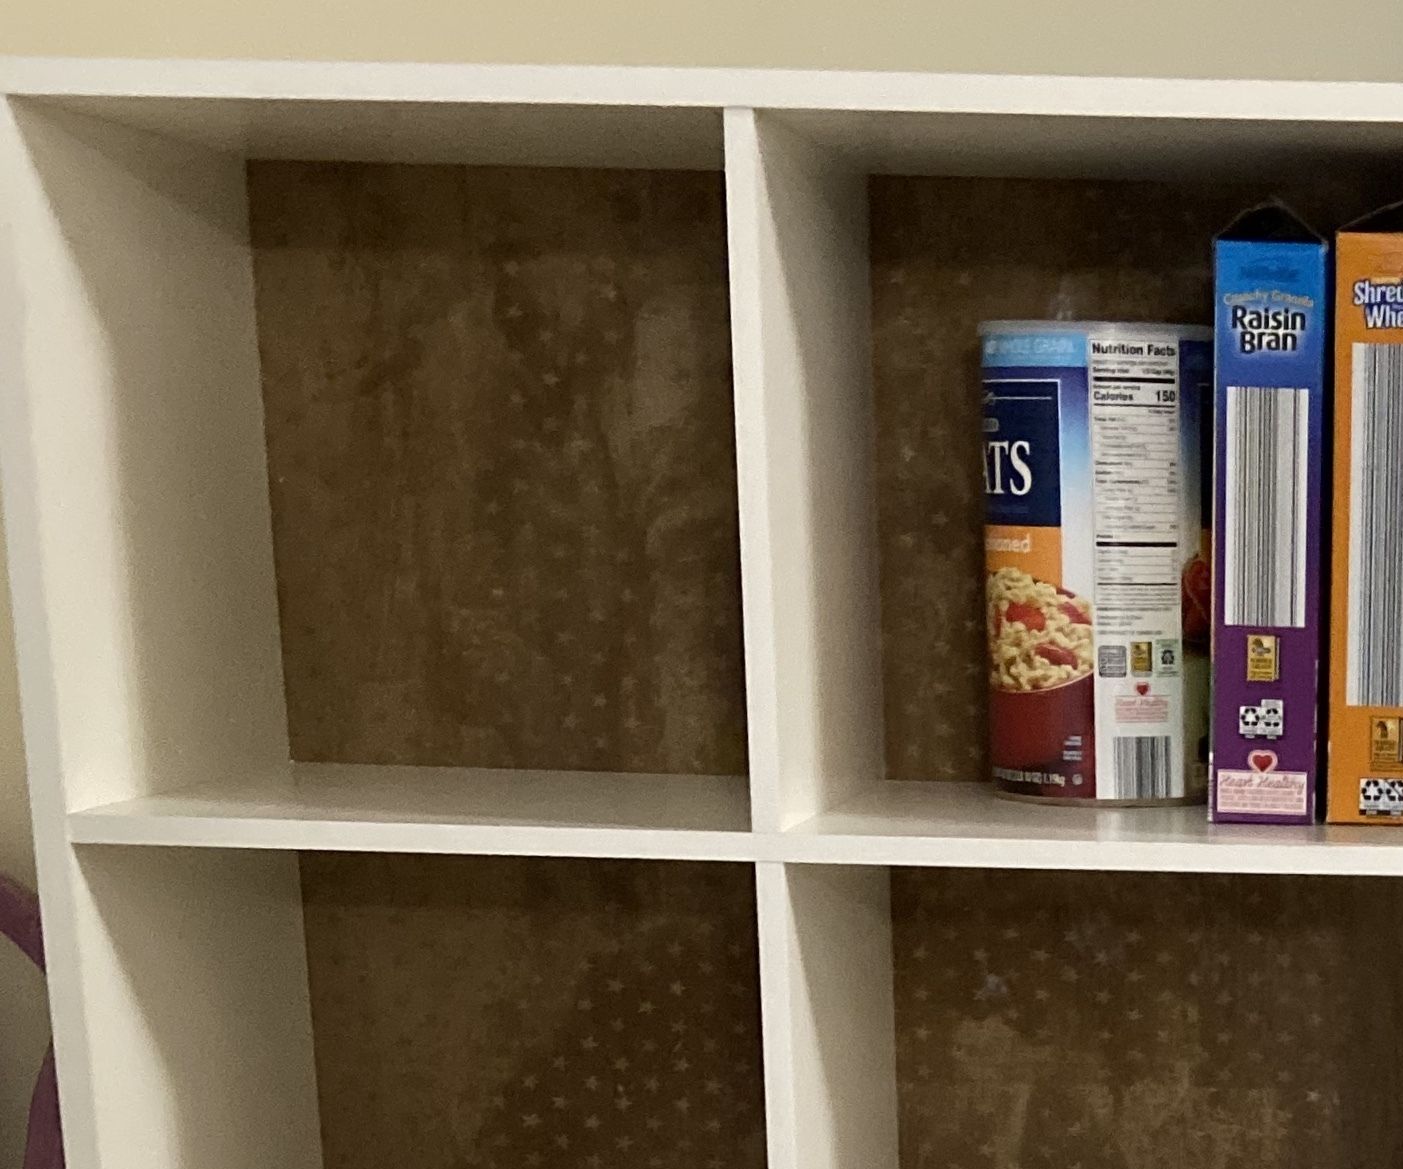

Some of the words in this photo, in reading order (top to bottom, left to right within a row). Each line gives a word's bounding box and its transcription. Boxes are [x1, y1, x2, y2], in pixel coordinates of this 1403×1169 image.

[1231, 304, 1307, 332] Raisin
[1092, 342, 1144, 356] Nutrition
[1146, 344, 1177, 357] Facts
[1240, 331, 1298, 354] Bran
[1093, 390, 1134, 401] Calories
[1155, 390, 1176, 402] 150
